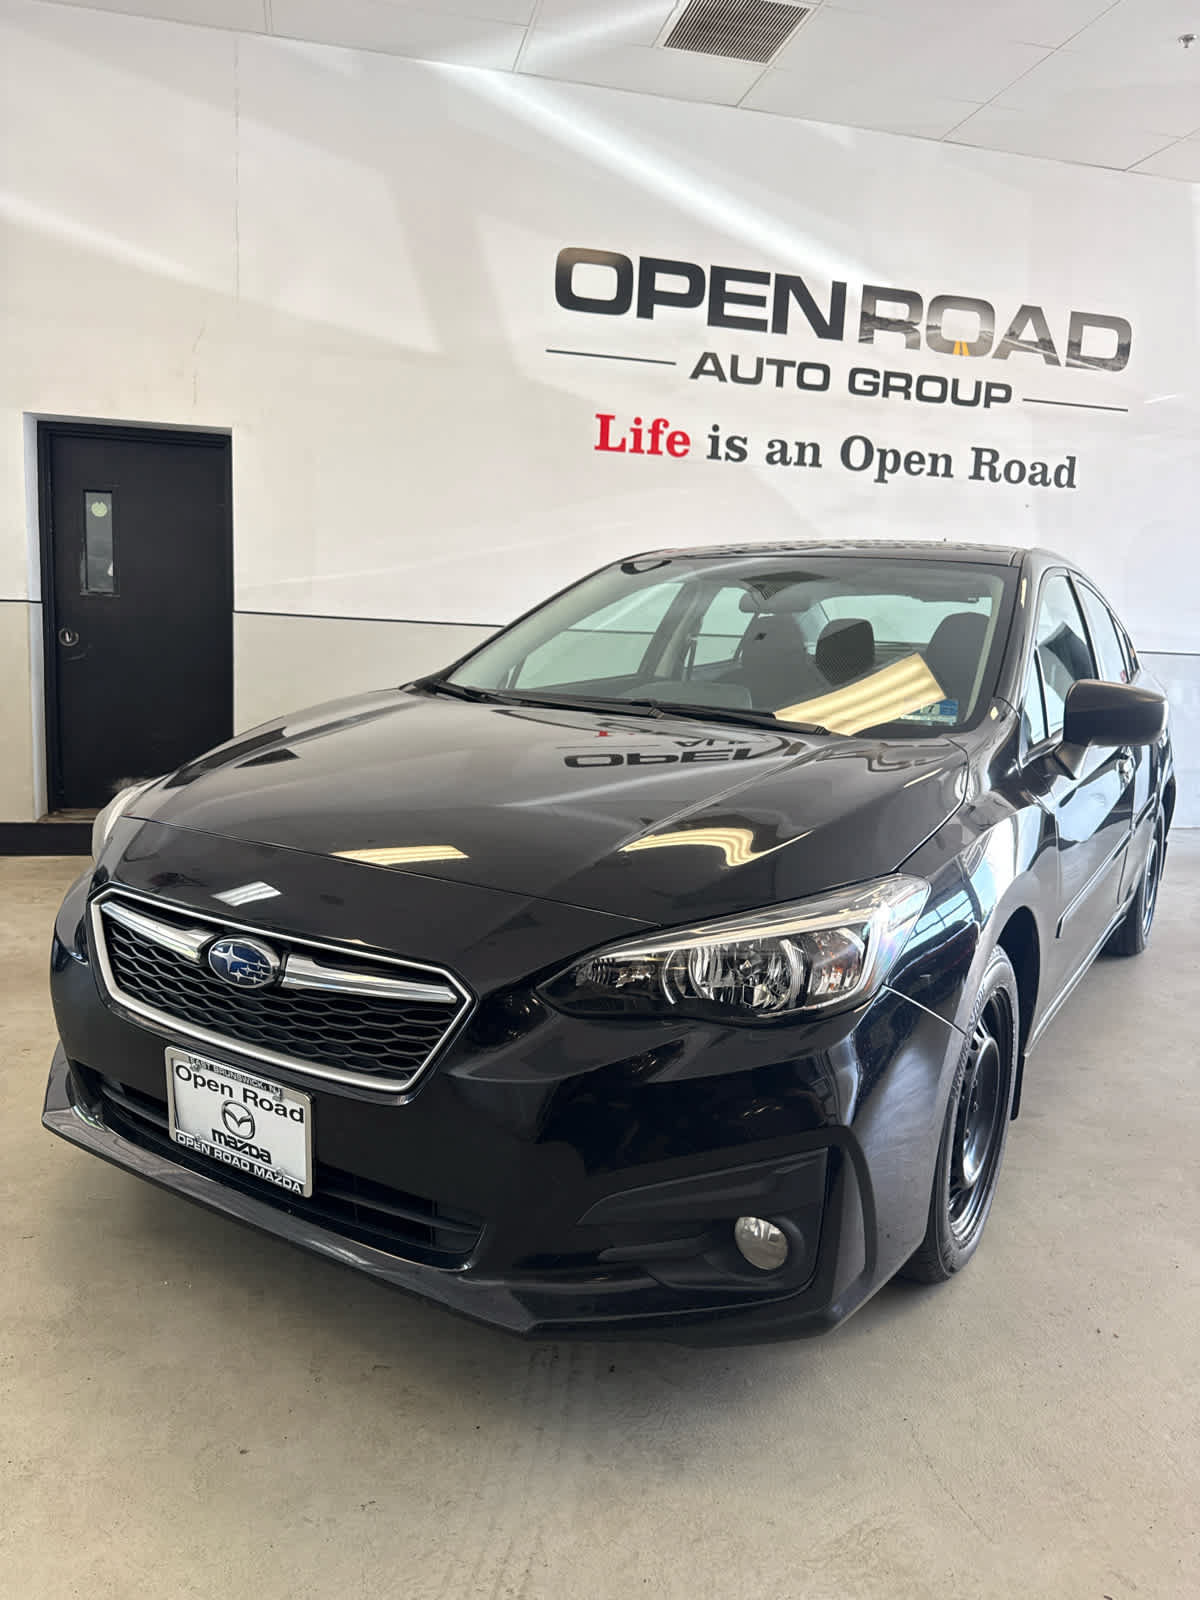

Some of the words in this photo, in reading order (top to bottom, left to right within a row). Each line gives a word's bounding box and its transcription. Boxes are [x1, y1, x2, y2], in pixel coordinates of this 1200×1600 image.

[554, 246, 847, 342] OPEN
[858, 283, 1133, 374] ROAD
[690, 351, 831, 392] AUTO
[847, 367, 1013, 409] GROUP
[594, 413, 691, 457] Life
[706, 425, 748, 462] is
[765, 438, 822, 468] an
[839, 434, 953, 483] Open
[968, 446, 1077, 489] Road
[175, 1064, 233, 1098] Open
[242, 1087, 304, 1123] Road
[177, 1134, 210, 1156] OPEN
[214, 1149, 250, 1171] ROAD
[254, 1165, 302, 1193] MAZDA
[211, 1128, 272, 1165] mazda
